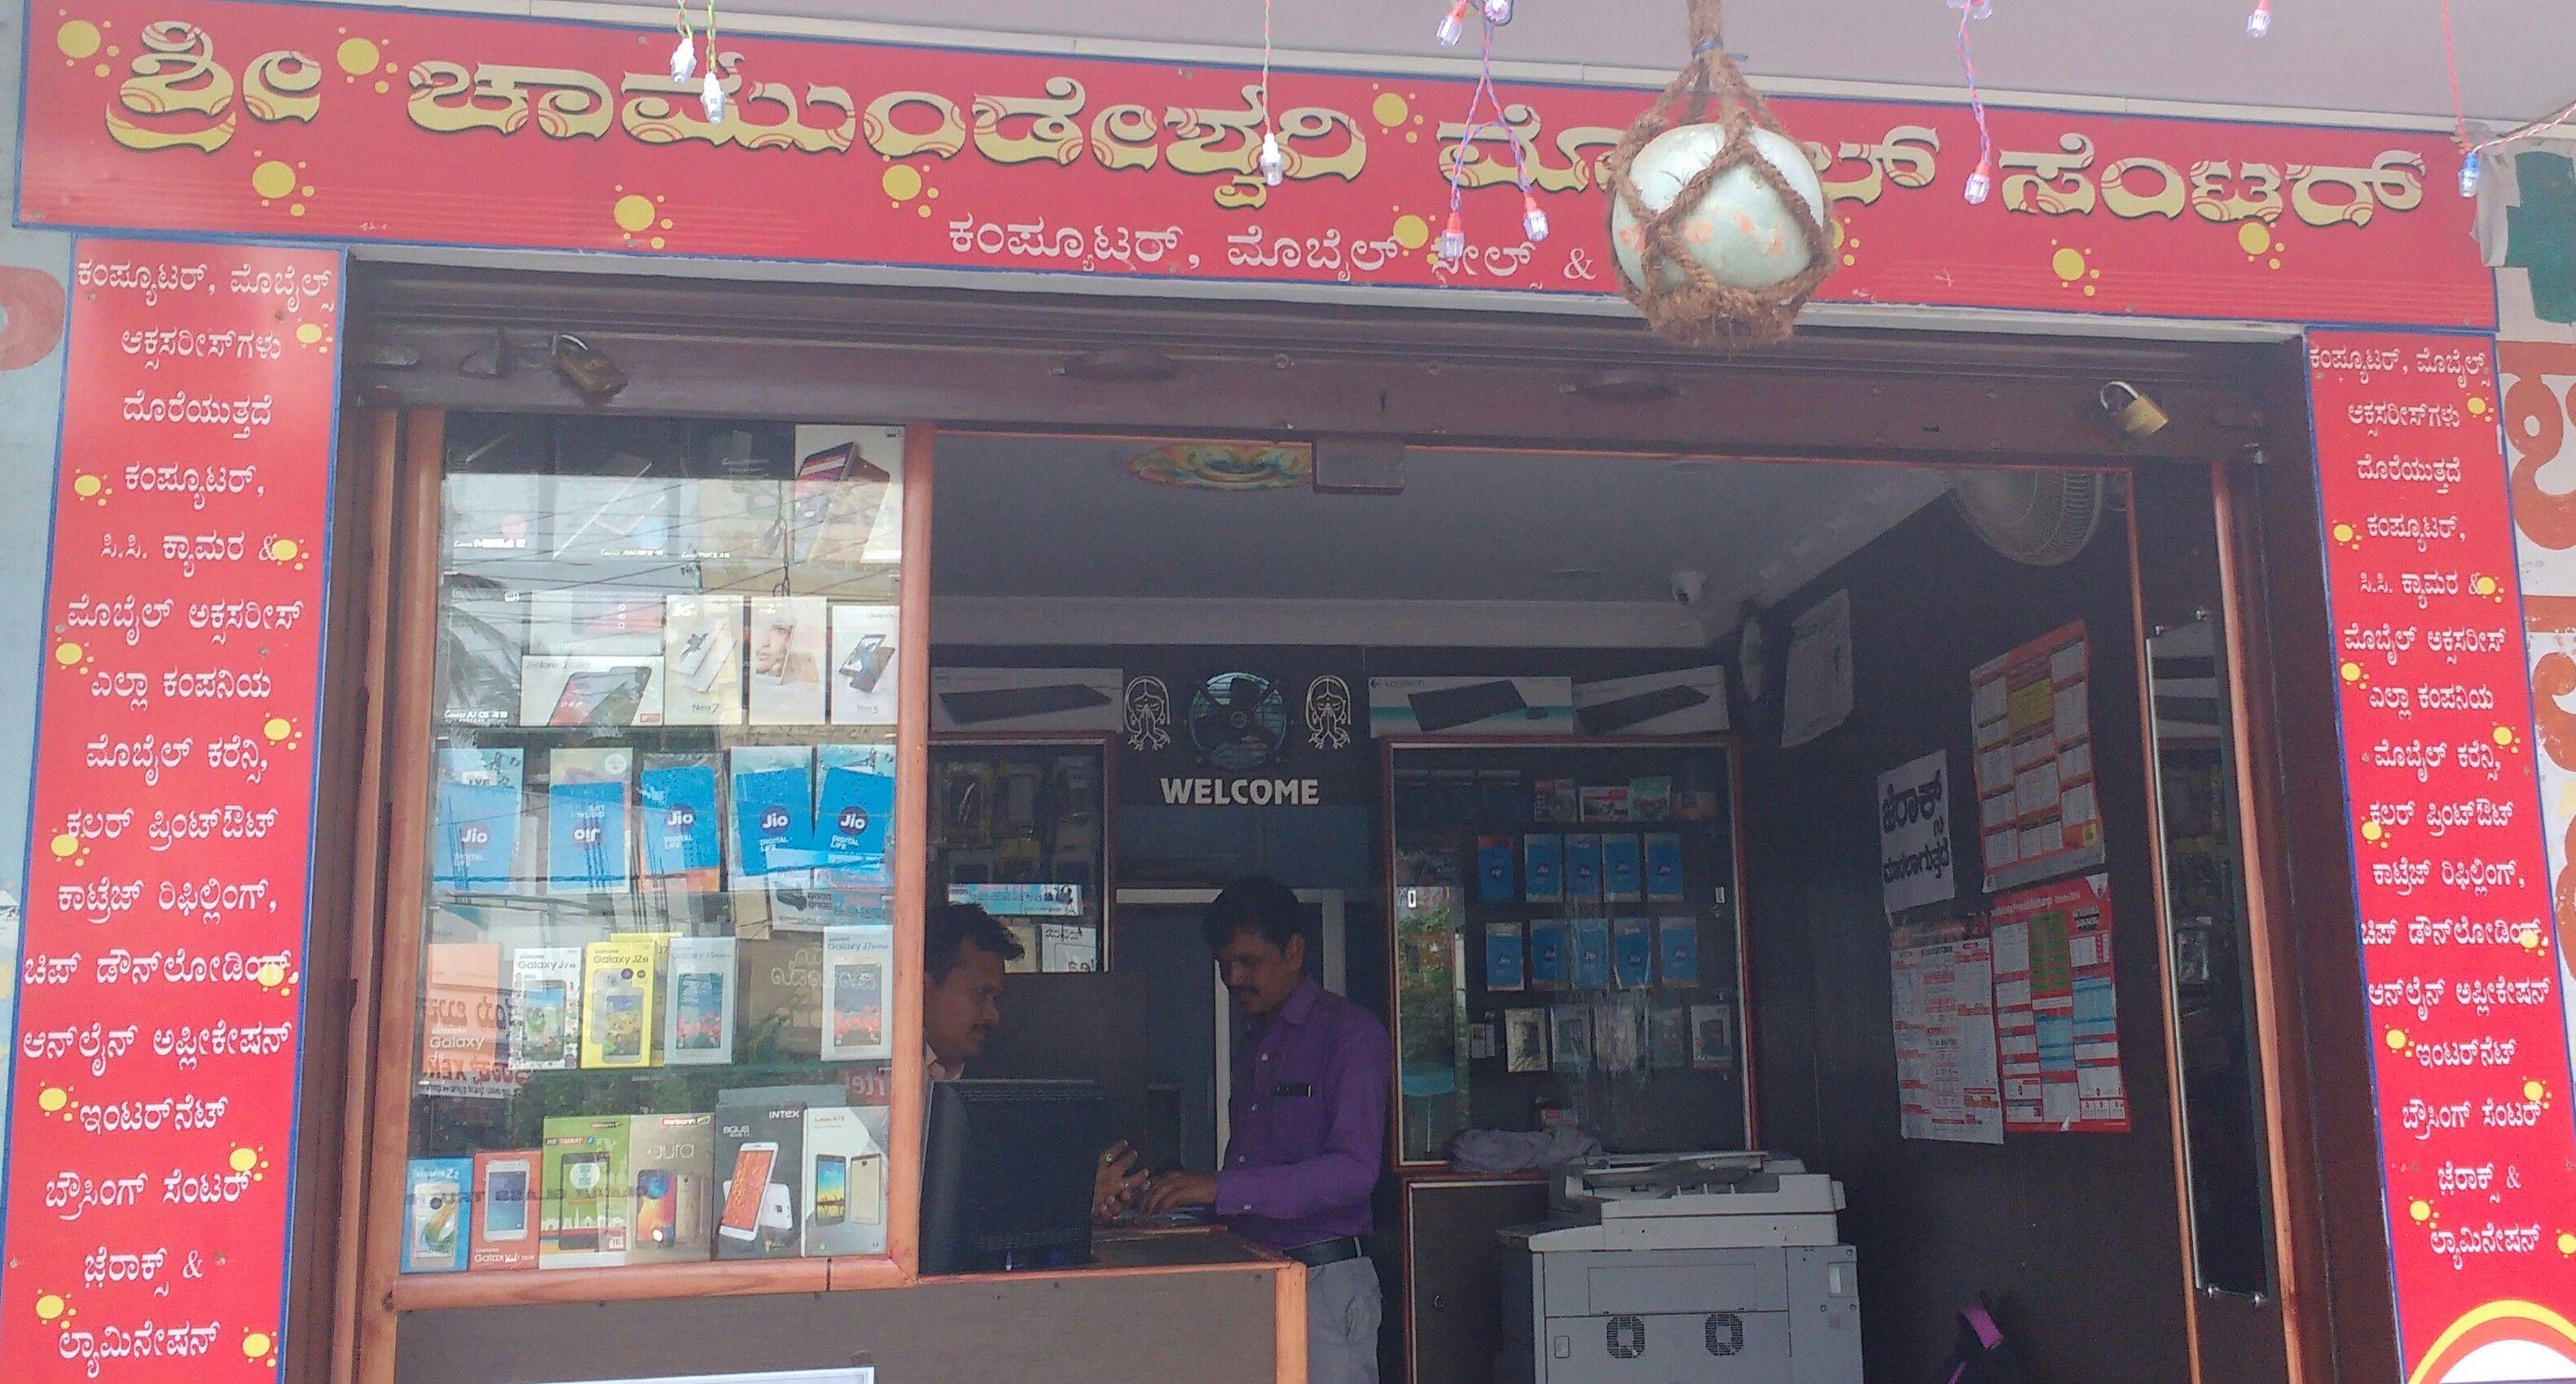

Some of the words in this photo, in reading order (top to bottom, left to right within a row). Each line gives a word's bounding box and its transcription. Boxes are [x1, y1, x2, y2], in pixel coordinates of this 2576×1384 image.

[106, 20, 323, 154] ಶ್ರೀ
[407, 51, 1368, 209] ಚಾಮುಂಡೇಶ್ವರಿ
[1998, 132, 2428, 229] ಸೆಂಟರ್
[948, 212, 1200, 272] ಕಂಪ್ಯೂಟರ್,
[1227, 227, 1403, 282] ಮೊಬೈಲ್
[1563, 248, 1598, 280] &
[78, 259, 216, 307] ಕಂಪ್ಯೂಟರ್,
[230, 262, 335, 313] ಮೊಬೈಲ್ಸ್
[2310, 345, 2408, 384] ಕಂಪ್ಯೂಟರ್,
[2416, 347, 2491, 388] ಮೊಬೈಲ್ಸ್
[123, 389, 272, 438] ದೊರೆಯುತ್ತದೆ
[125, 460, 264, 510] ಕಂಪ್ಯೂಟರ್,
[2357, 453, 2461, 494] ದೊರೆಯುತ್ತದೆ
[2367, 513, 2466, 553] ಕಂಪ್ಯೂಟರ್,
[100, 532, 147, 560] ಸಿ.ಸಿ.
[163, 529, 246, 578] ಕ್ಯಾಮರ
[2401, 569, 2459, 610] ಕ್ಯಾಮರ
[67, 593, 174, 645] ಮೊಬೈಲ್
[2344, 622, 2417, 666] ಮೊಬೈಲ್
[91, 670, 148, 711] ಎಲ್ಲಾ
[163, 666, 271, 699] ಕಂಪನಿಯ
[2369, 685, 2411, 721] ಎಲ್ಲಾ
[2417, 683, 2494, 710] ಕಂಪನಿಯ
[86, 733, 193, 786] ಮೊಬೈಲ್
[2374, 738, 2447, 782] ಮೊಬೈಲ್
[1160, 778, 1320, 806] WELCOME
[66, 806, 134, 839] ಕಲರ್
[667, 811, 693, 826] Jio
[763, 813, 789, 828] Jio
[840, 813, 865, 829] Jio
[2368, 799, 2416, 827] ಕಲರ್
[461, 828, 487, 844] Jio
[574, 828, 600, 843] Jio
[759, 836, 789, 846] DIGITAL
[831, 835, 859, 846] DIGITAL
[593, 955, 631, 964] Galaxy
[828, 943, 861, 951] Galaxy
[24, 952, 82, 984] ಚಿಪ್
[518, 960, 556, 971] Galaxy
[429, 1035, 485, 1051] Galaxy
[768, 1109, 800, 1119] INTEX
[2402, 1098, 2471, 1140] ಬ್ರೌಸಿಂಗ್
[2481, 1097, 2543, 1127] ಸೆಂಟರ್
[648, 1142, 694, 1160] aura
[2506, 1164, 2522, 1189] &
[45, 1170, 148, 1221] ಬ್ರೌಸಿಂಗ್
[163, 1168, 252, 1204] ಸೆಂಟರ್
[474, 1253, 509, 1263] Galaxy
[2429, 1222, 2541, 1271] ಲ್ಯಾಮಿನೇಷನ್
[182, 1250, 204, 1279] &
[59, 1320, 221, 1378] ಲ್ಯಾಮಿನೇಷನ್
